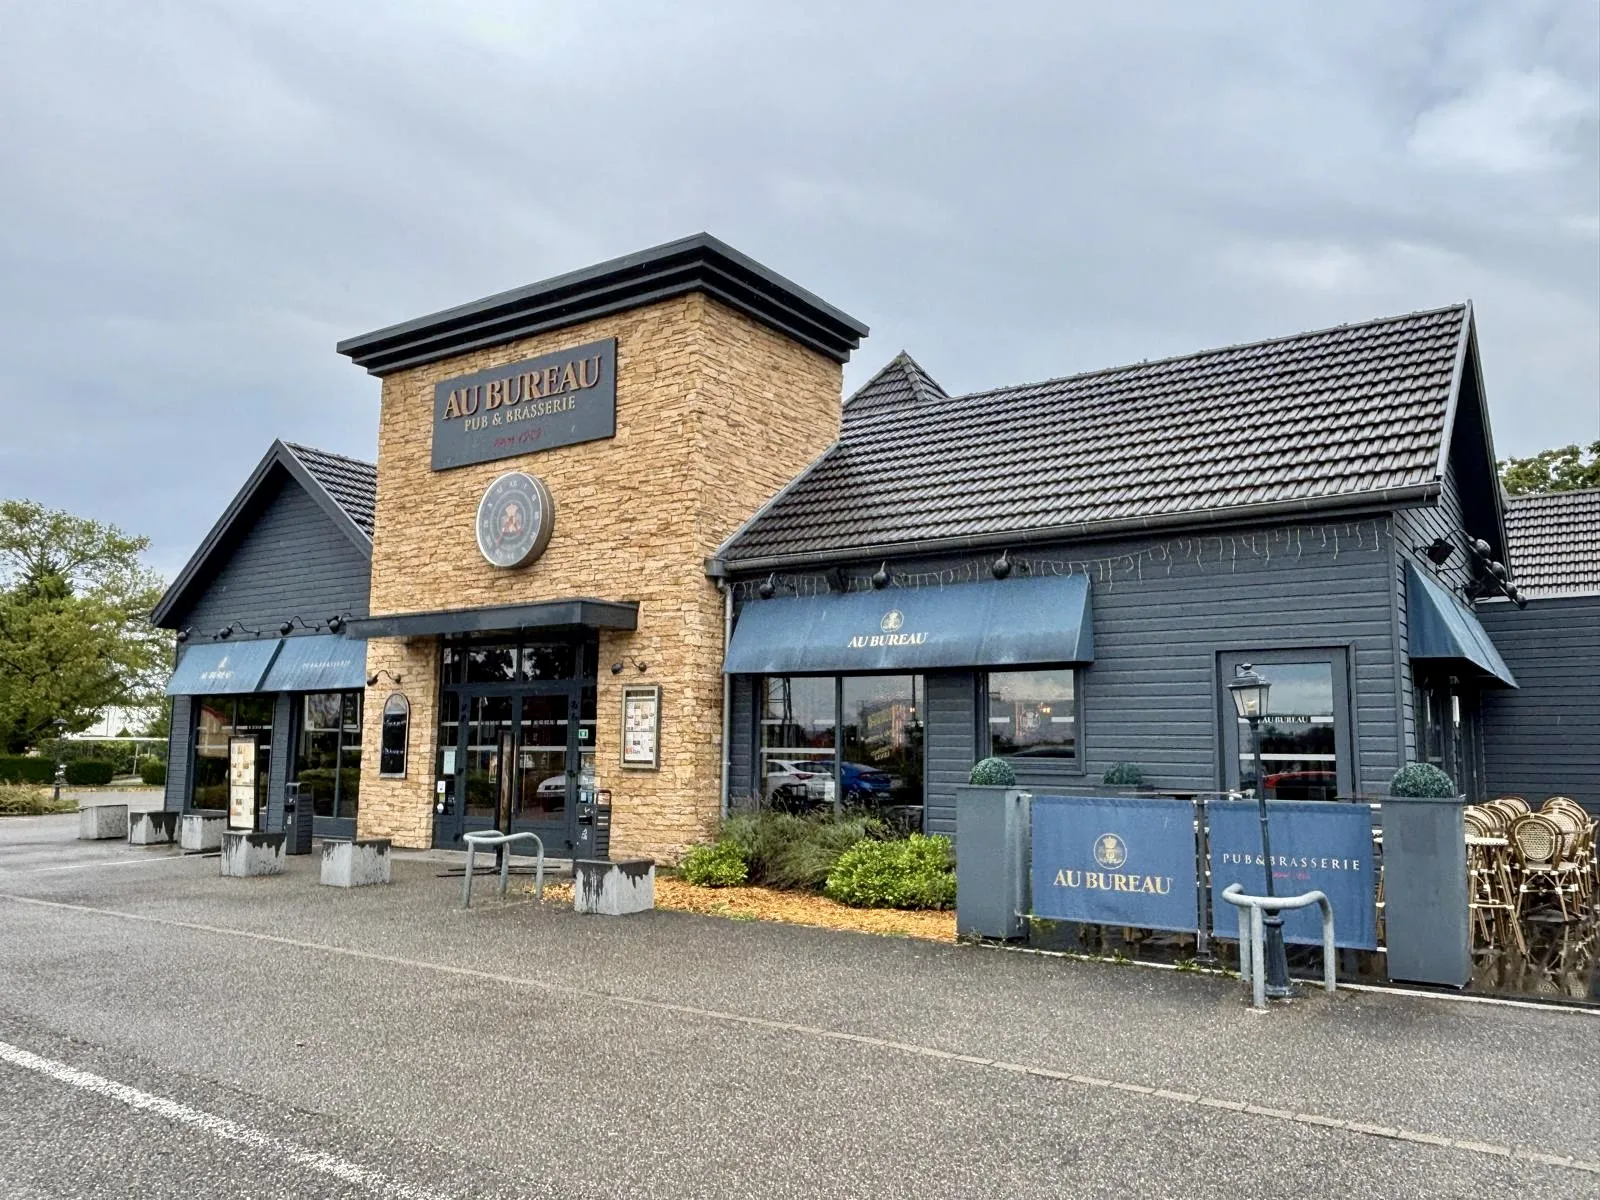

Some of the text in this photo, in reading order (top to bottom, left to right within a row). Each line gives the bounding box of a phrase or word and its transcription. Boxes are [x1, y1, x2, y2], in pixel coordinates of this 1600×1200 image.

[443, 354, 602, 420] AU BUREAU
[464, 396, 576, 432] PUB & BRASSERIE
[847, 632, 929, 648] AU BUREAU
[1053, 868, 1174, 895] AU BUREAU
